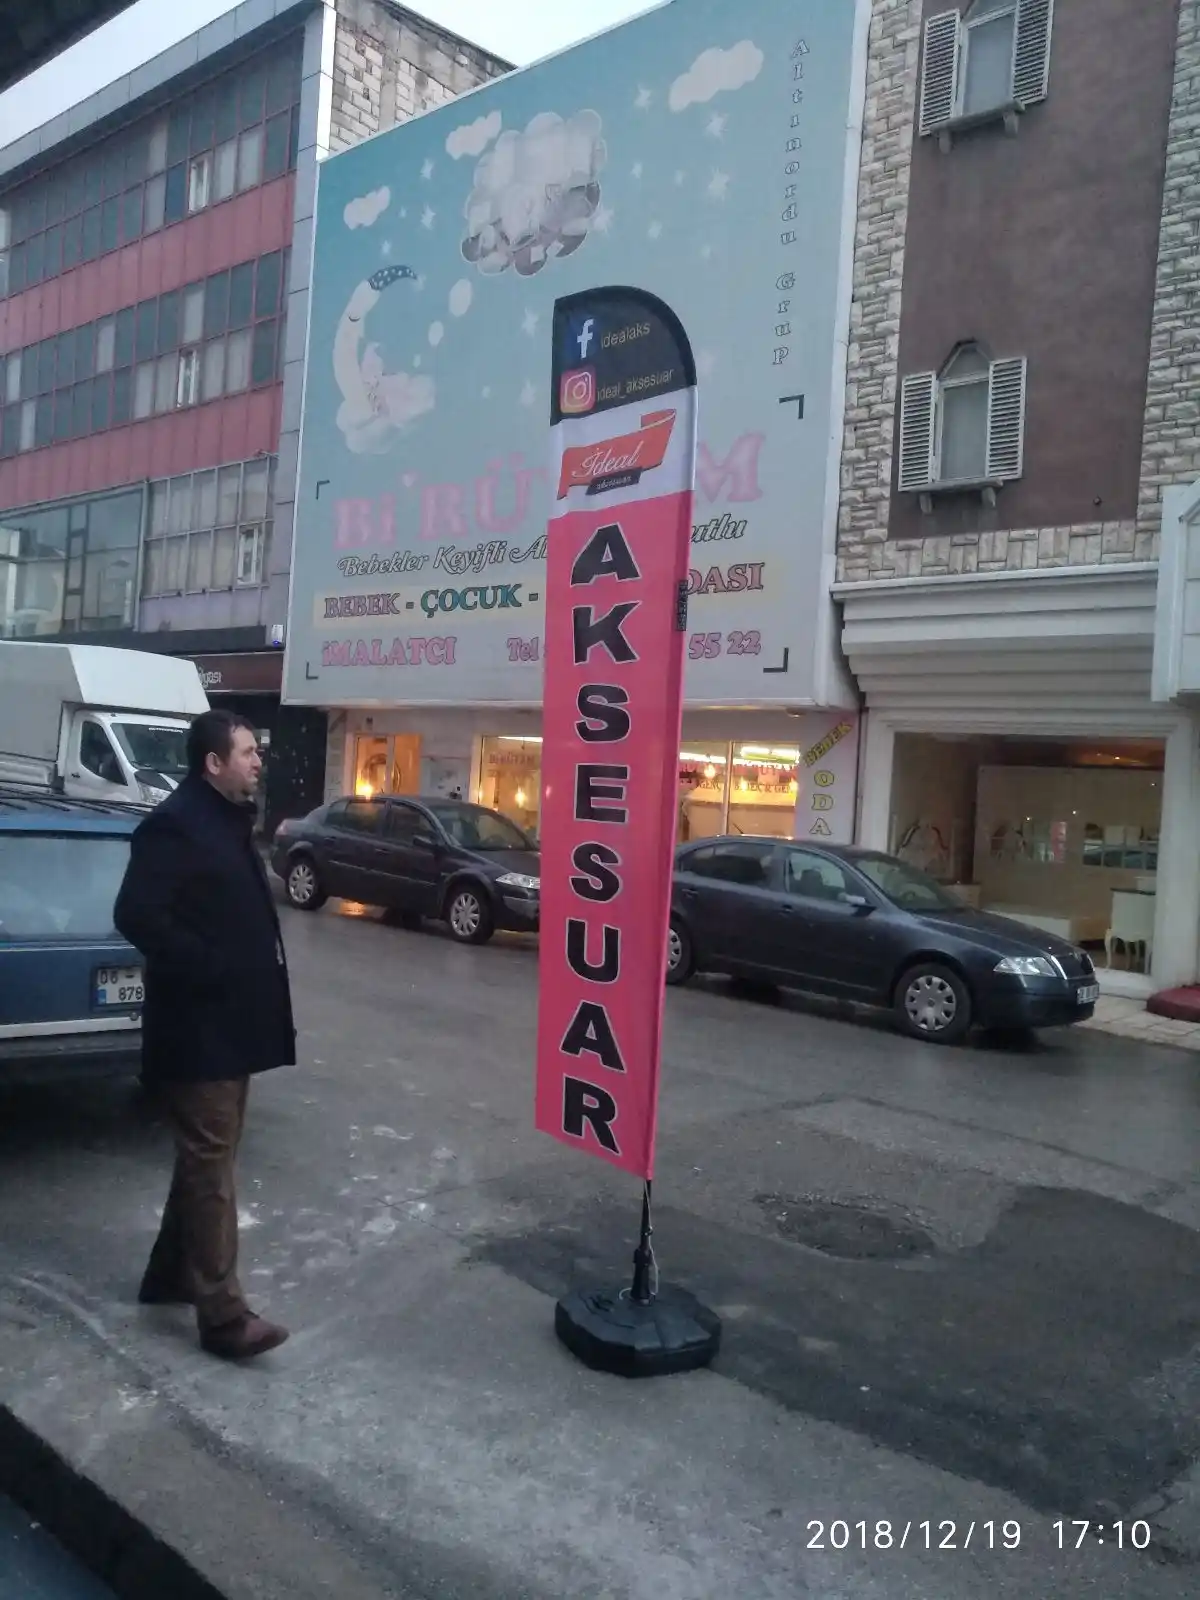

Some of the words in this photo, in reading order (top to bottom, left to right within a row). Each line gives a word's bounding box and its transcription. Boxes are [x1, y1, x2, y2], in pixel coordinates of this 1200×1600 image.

[601, 321, 651, 350] idealaks
[337, 550, 429, 577] Bebekler
[433, 540, 508, 575] Keyifli
[690, 513, 748, 543] utlu
[324, 593, 400, 618] BEBEK
[420, 583, 523, 618] ÇOCUK
[686, 562, 765, 596] DASI
[727, 630, 762, 656] 22
[809, 769, 835, 836] ODA
[558, 522, 642, 1157] AKSESUAR
